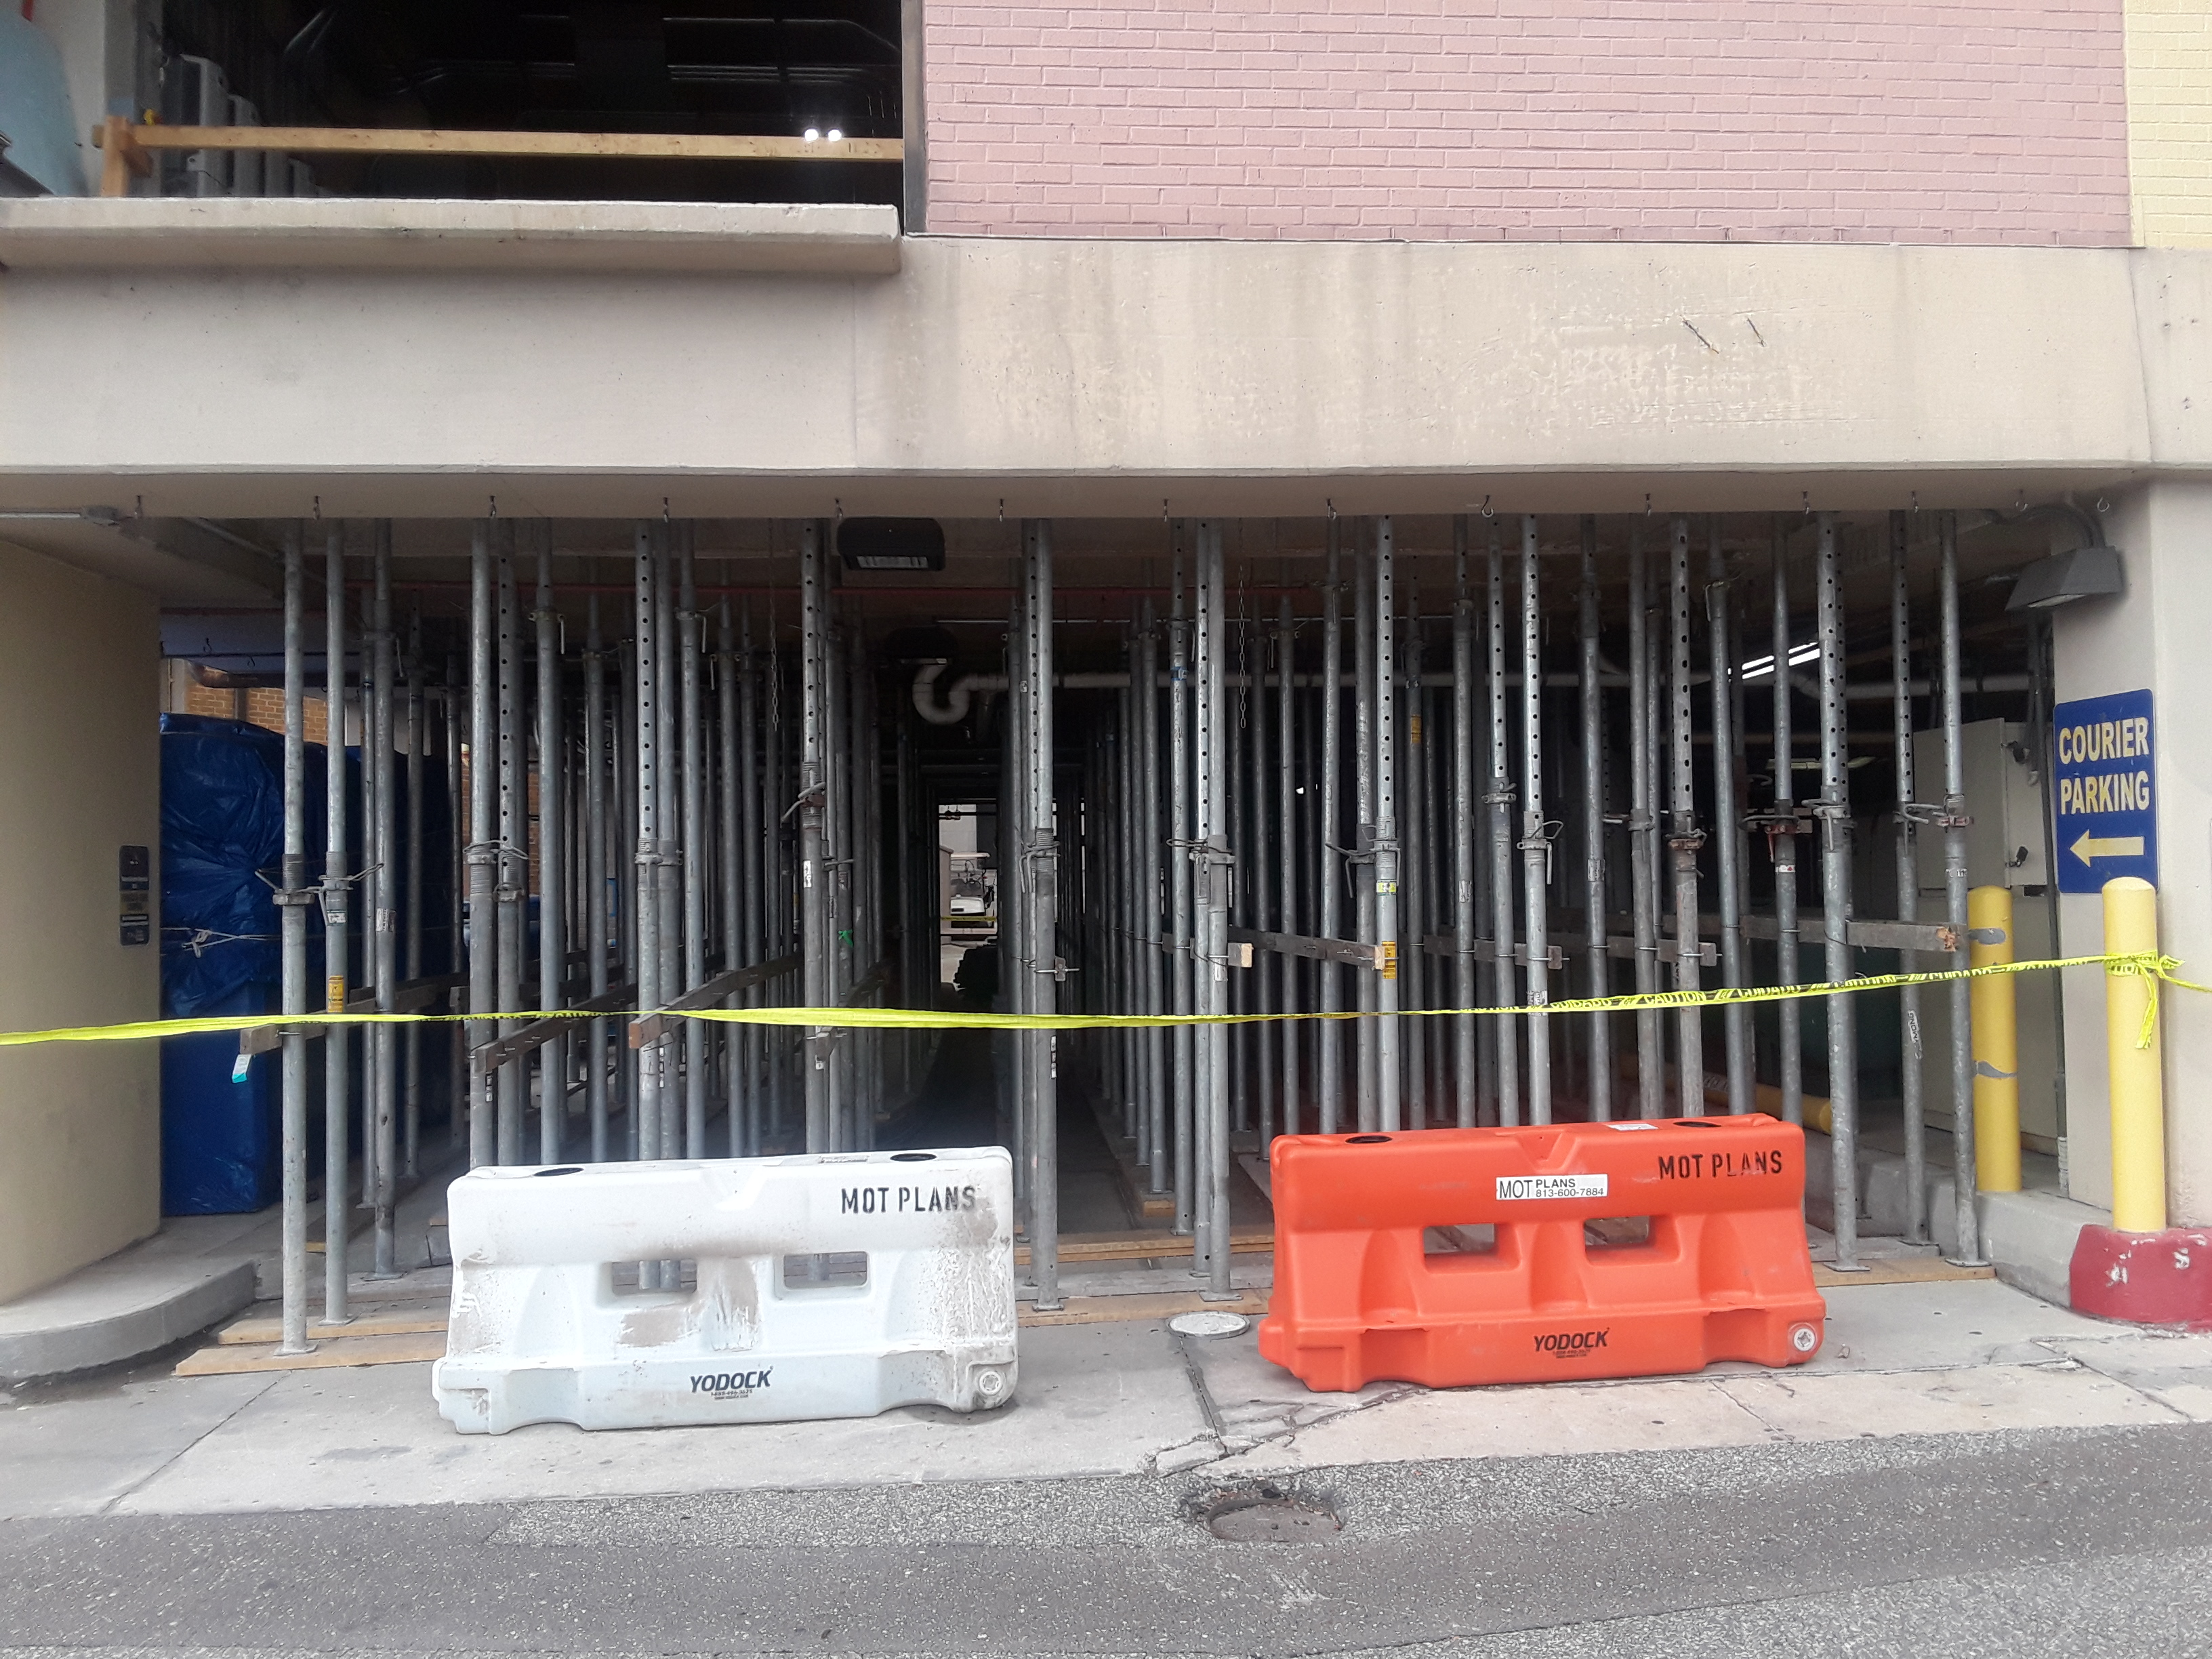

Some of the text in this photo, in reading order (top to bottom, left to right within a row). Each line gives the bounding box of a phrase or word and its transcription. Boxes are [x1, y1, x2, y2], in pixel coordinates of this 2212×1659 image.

[2059, 717, 2150, 764] COURIER
[2060, 770, 2150, 815] PARKING
[1644, 991, 1706, 1004] CAUTION
[1658, 1150, 1782, 1180] MOT PLANS
[841, 1186, 976, 1214] MOT PLANS
[1499, 1178, 1576, 1199] MOT PLANS
[1535, 1187, 1604, 1197] 813-600-7884
[1534, 1330, 1609, 1352] YODOCK
[690, 1370, 772, 1393] YODOCK
